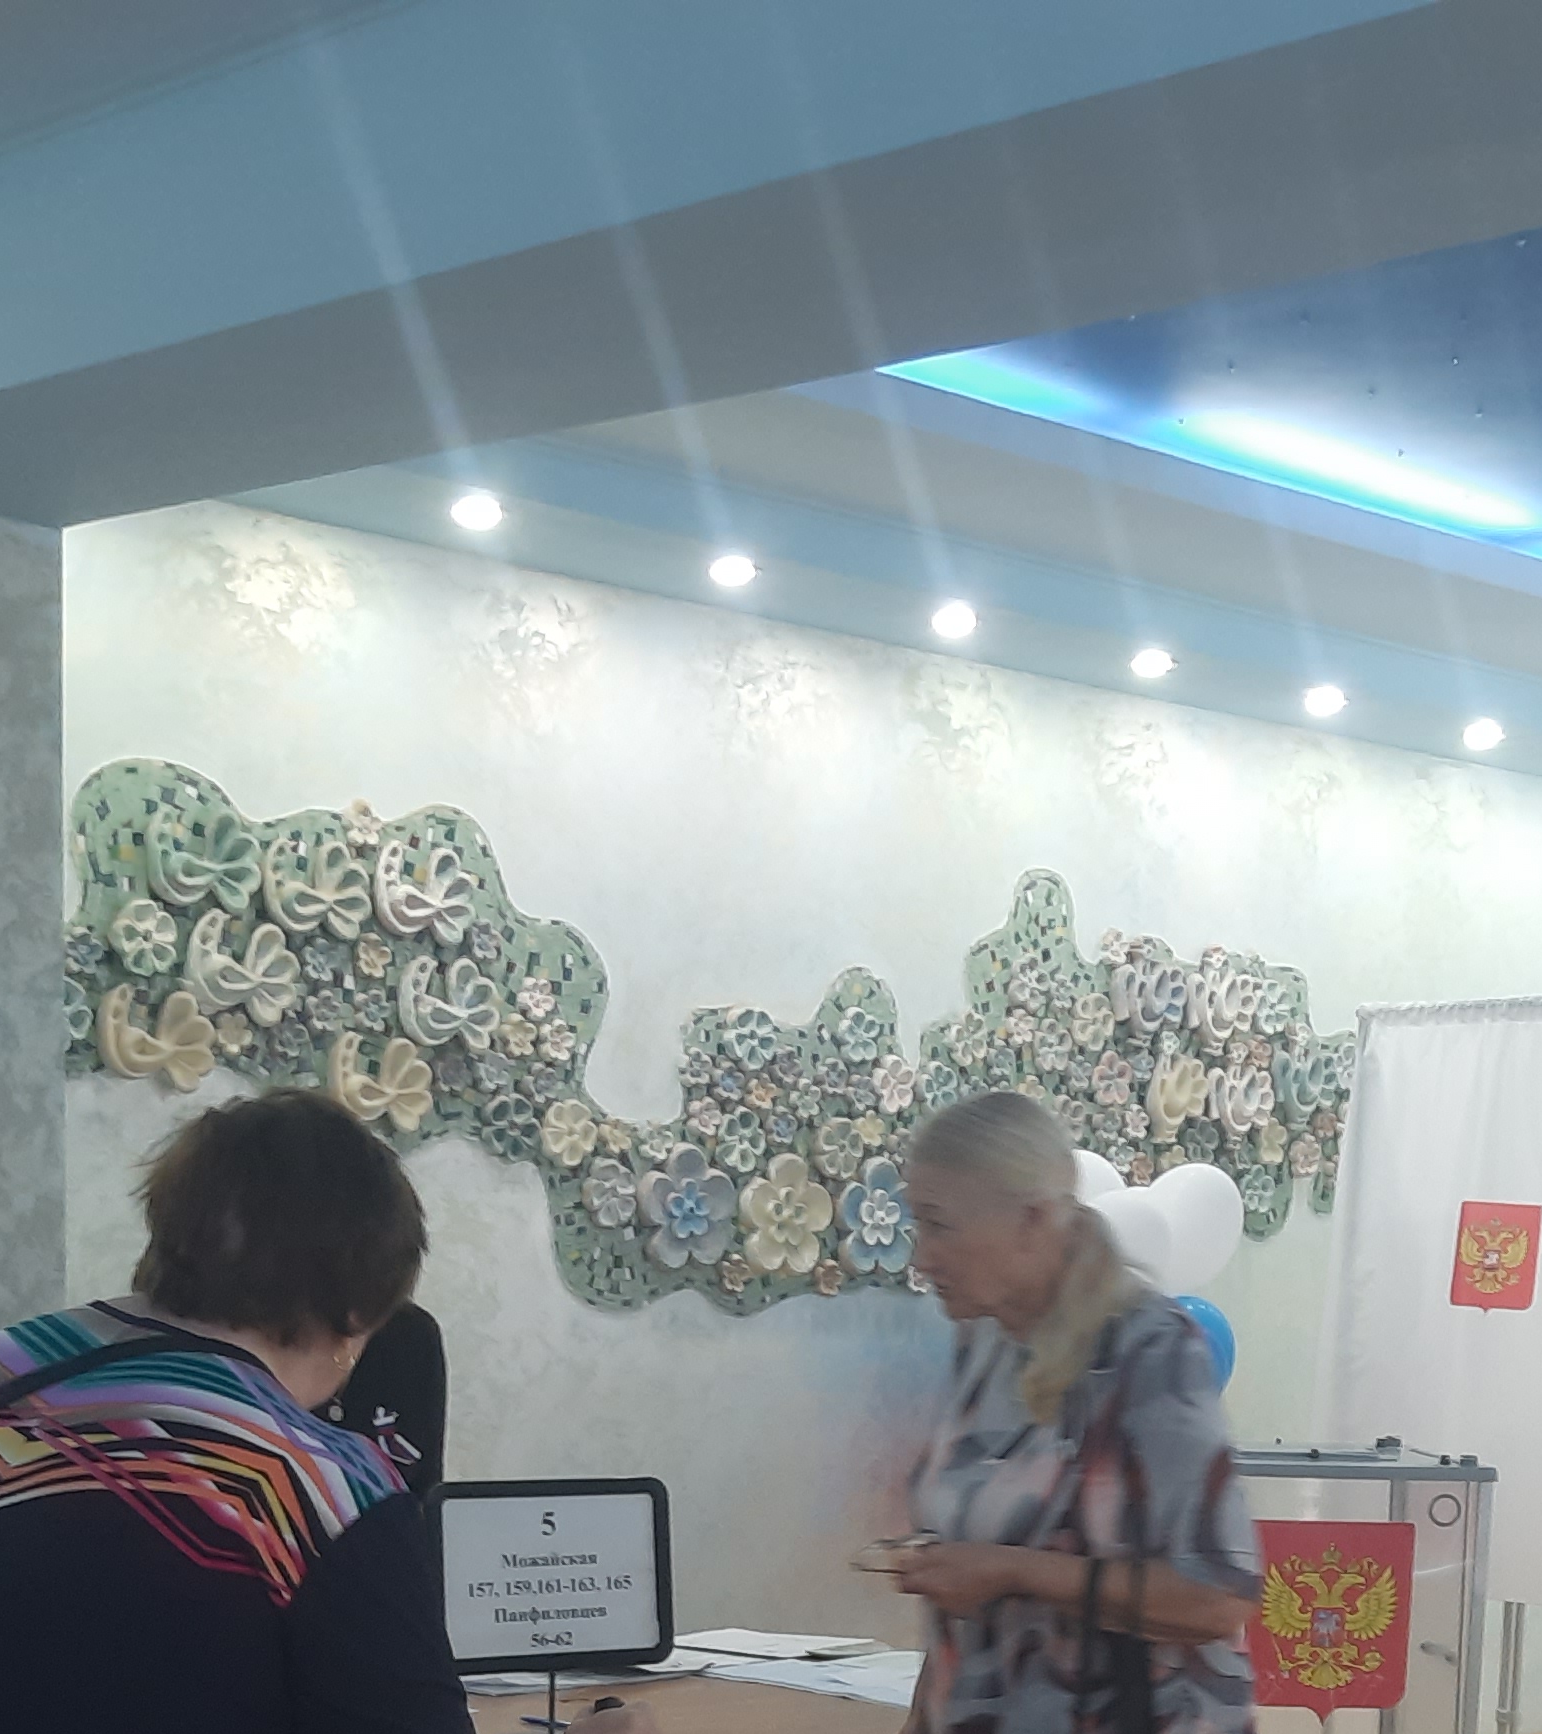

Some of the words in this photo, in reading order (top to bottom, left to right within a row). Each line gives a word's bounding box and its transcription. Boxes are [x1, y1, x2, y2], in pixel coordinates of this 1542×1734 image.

[541, 1511, 557, 1536] 5
[501, 1552, 598, 1569] Можайская
[467, 1582, 500, 1598] 157,
[606, 1575, 633, 1590] 165
[494, 1605, 608, 1625] Панфиловцев
[531, 1632, 573, 1648] 56-62
